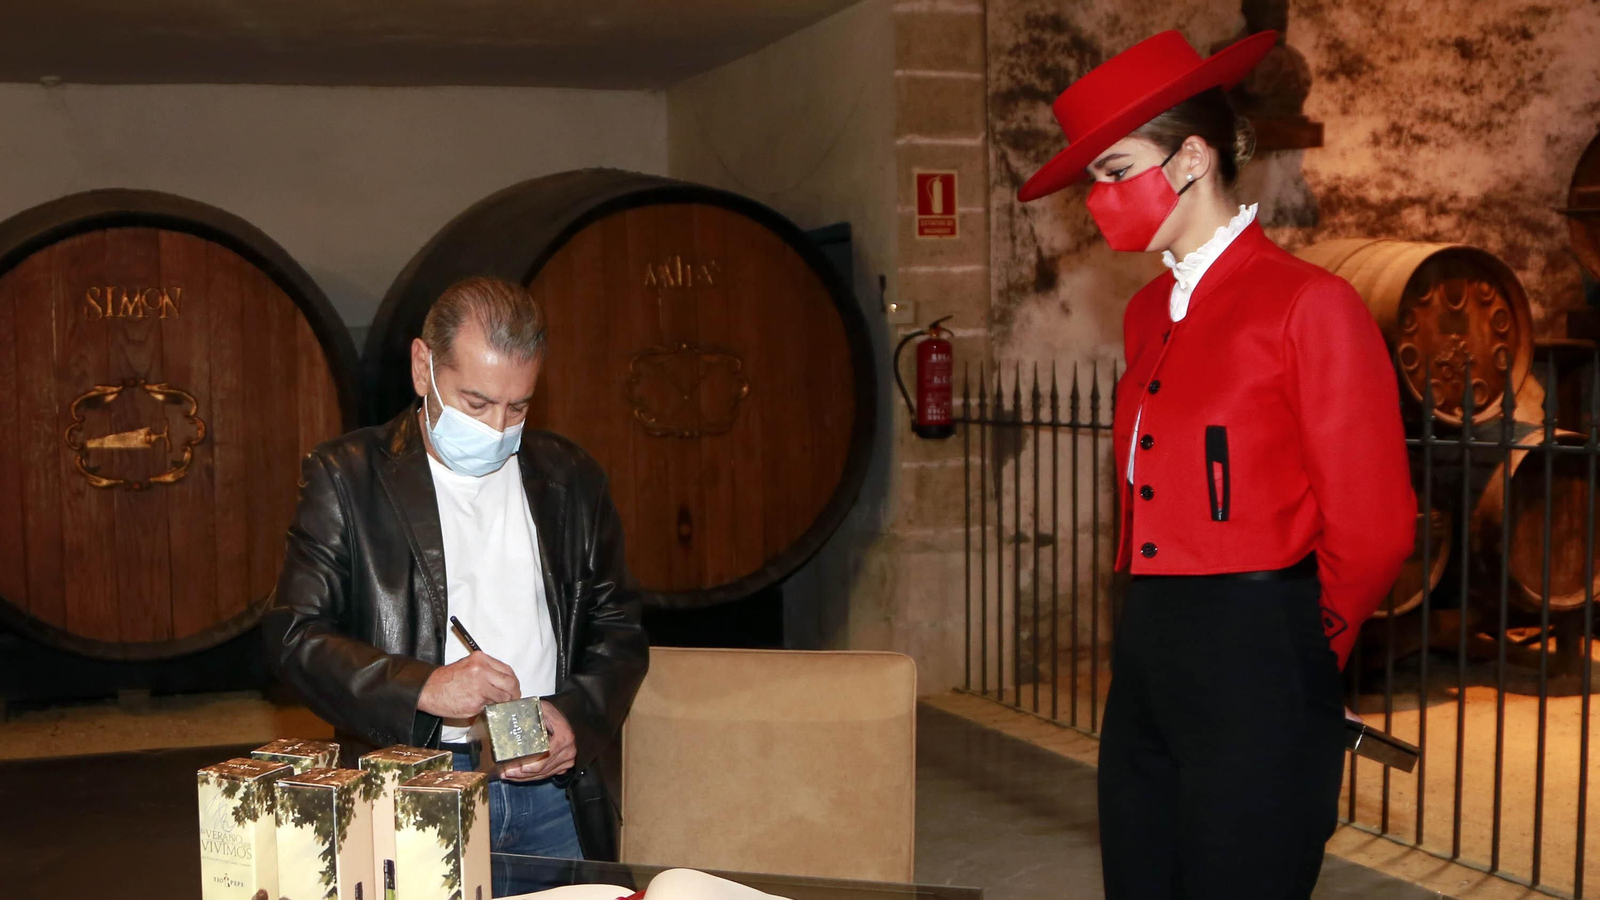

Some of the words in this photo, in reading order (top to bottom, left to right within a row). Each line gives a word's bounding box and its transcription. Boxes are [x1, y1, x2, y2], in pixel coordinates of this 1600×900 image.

[84, 286, 181, 321] SIMON
[205, 829, 243, 844] VERANO
[201, 840, 253, 860] VIVIMOS
